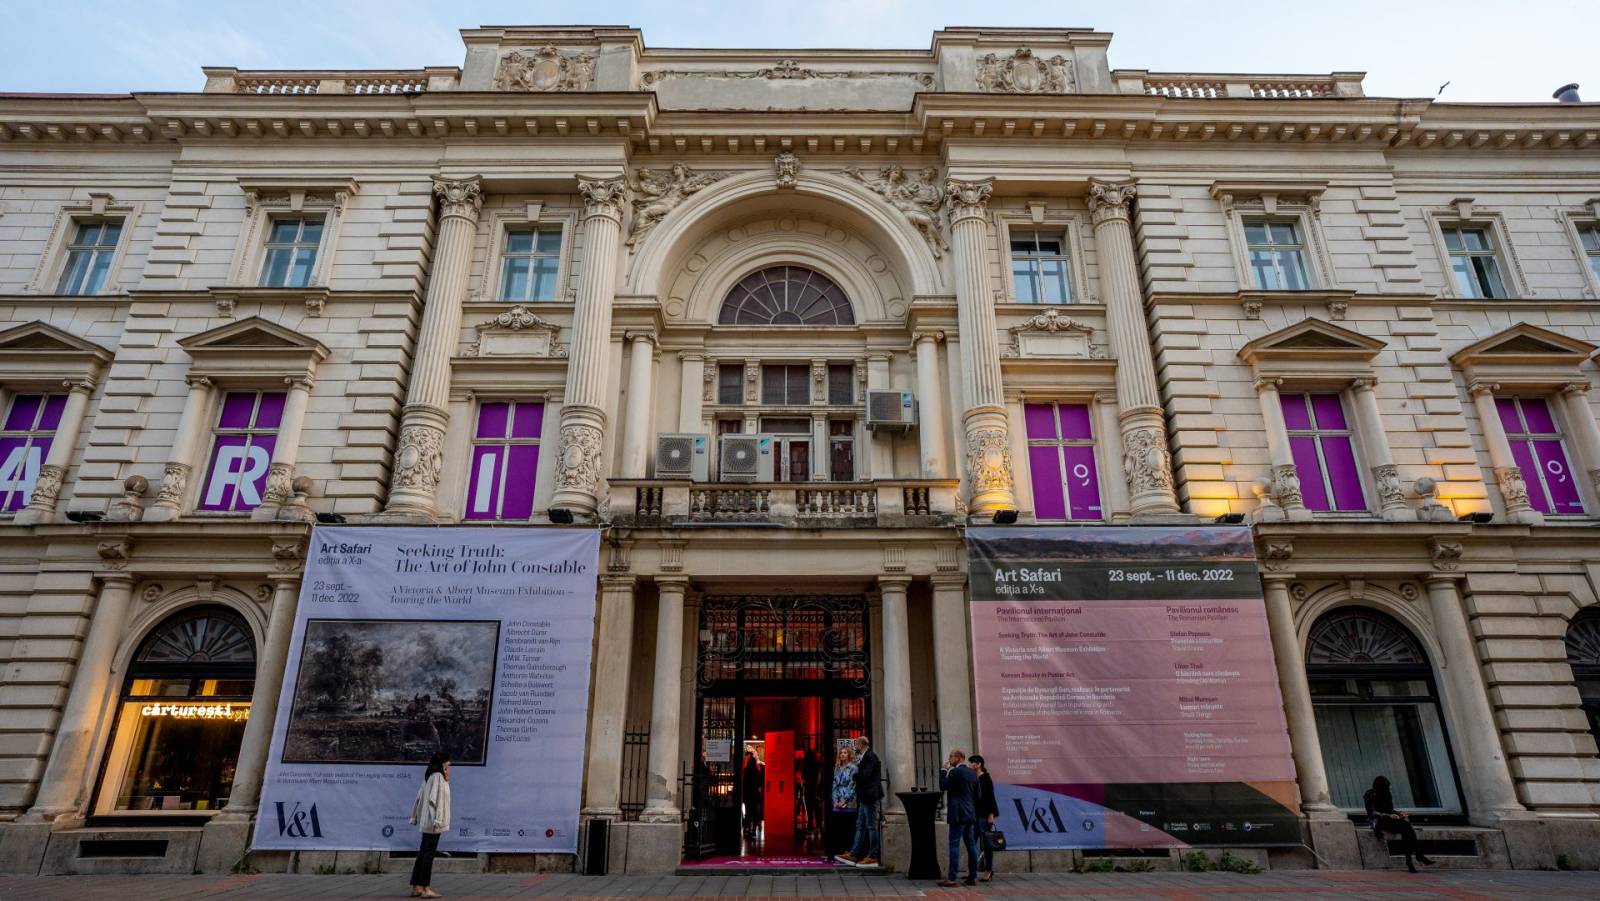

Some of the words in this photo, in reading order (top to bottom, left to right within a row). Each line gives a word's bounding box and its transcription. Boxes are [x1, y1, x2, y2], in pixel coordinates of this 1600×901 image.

[0, 446, 42, 506] A
[205, 445, 269, 505] R
[320, 543, 338, 554] Art
[340, 543, 372, 555] Safari
[397, 543, 454, 560] Seeking
[460, 543, 505, 558] Truth:
[349, 556, 362, 565] X-a
[394, 559, 423, 573] The
[424, 557, 449, 573] Art
[453, 559, 470, 573] of
[471, 560, 506, 574] John
[511, 560, 586, 575] Constable
[995, 568, 1018, 582] Art
[1020, 568, 1061, 582] Safari
[1108, 570, 1124, 582] 23
[1126, 571, 1155, 584] sept.
[1165, 570, 1175, 581] 11
[1178, 570, 1200, 582] dec.
[1202, 569, 1234, 581] 2022
[313, 581, 325, 591] 23
[326, 582, 345, 594] sept.
[400, 586, 434, 595] Victoria
[446, 586, 474, 595] Albert
[475, 587, 515, 595] Museum
[518, 587, 565, 597] Exhibition
[1022, 586, 1028, 594] a
[1029, 584, 1045, 594] X-a
[312, 593, 318, 602] 11
[337, 593, 359, 603] 2022
[390, 595, 424, 606] Touring
[426, 596, 442, 605] the
[444, 596, 472, 605] World
[997, 607, 1032, 615] Pavilionul
[1166, 606, 1202, 614] Pavilionul
[273, 801, 324, 838] V&A
[1012, 797, 1069, 834] V&A
